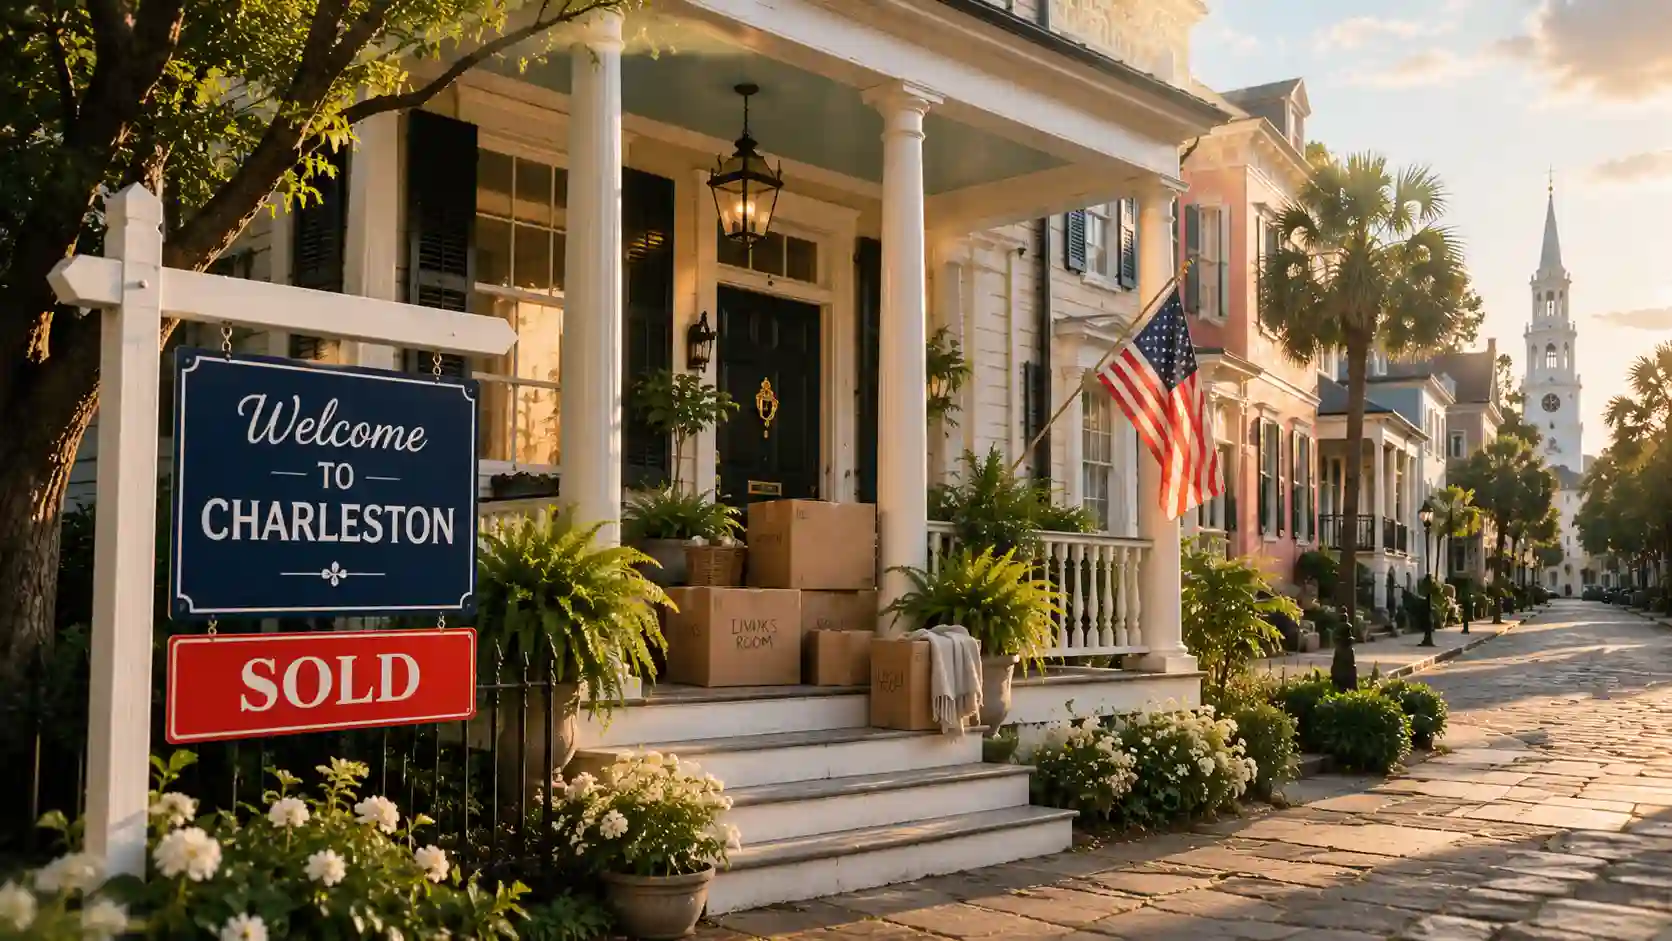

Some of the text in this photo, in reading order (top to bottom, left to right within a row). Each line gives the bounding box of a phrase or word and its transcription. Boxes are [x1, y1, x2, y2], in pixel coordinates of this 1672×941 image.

[237, 393, 428, 453] Welcome
[317, 461, 354, 490] TO
[201, 497, 455, 545] CHARLESTON
[736, 635, 774, 650] ROOM
[240, 652, 421, 713] SOLD
